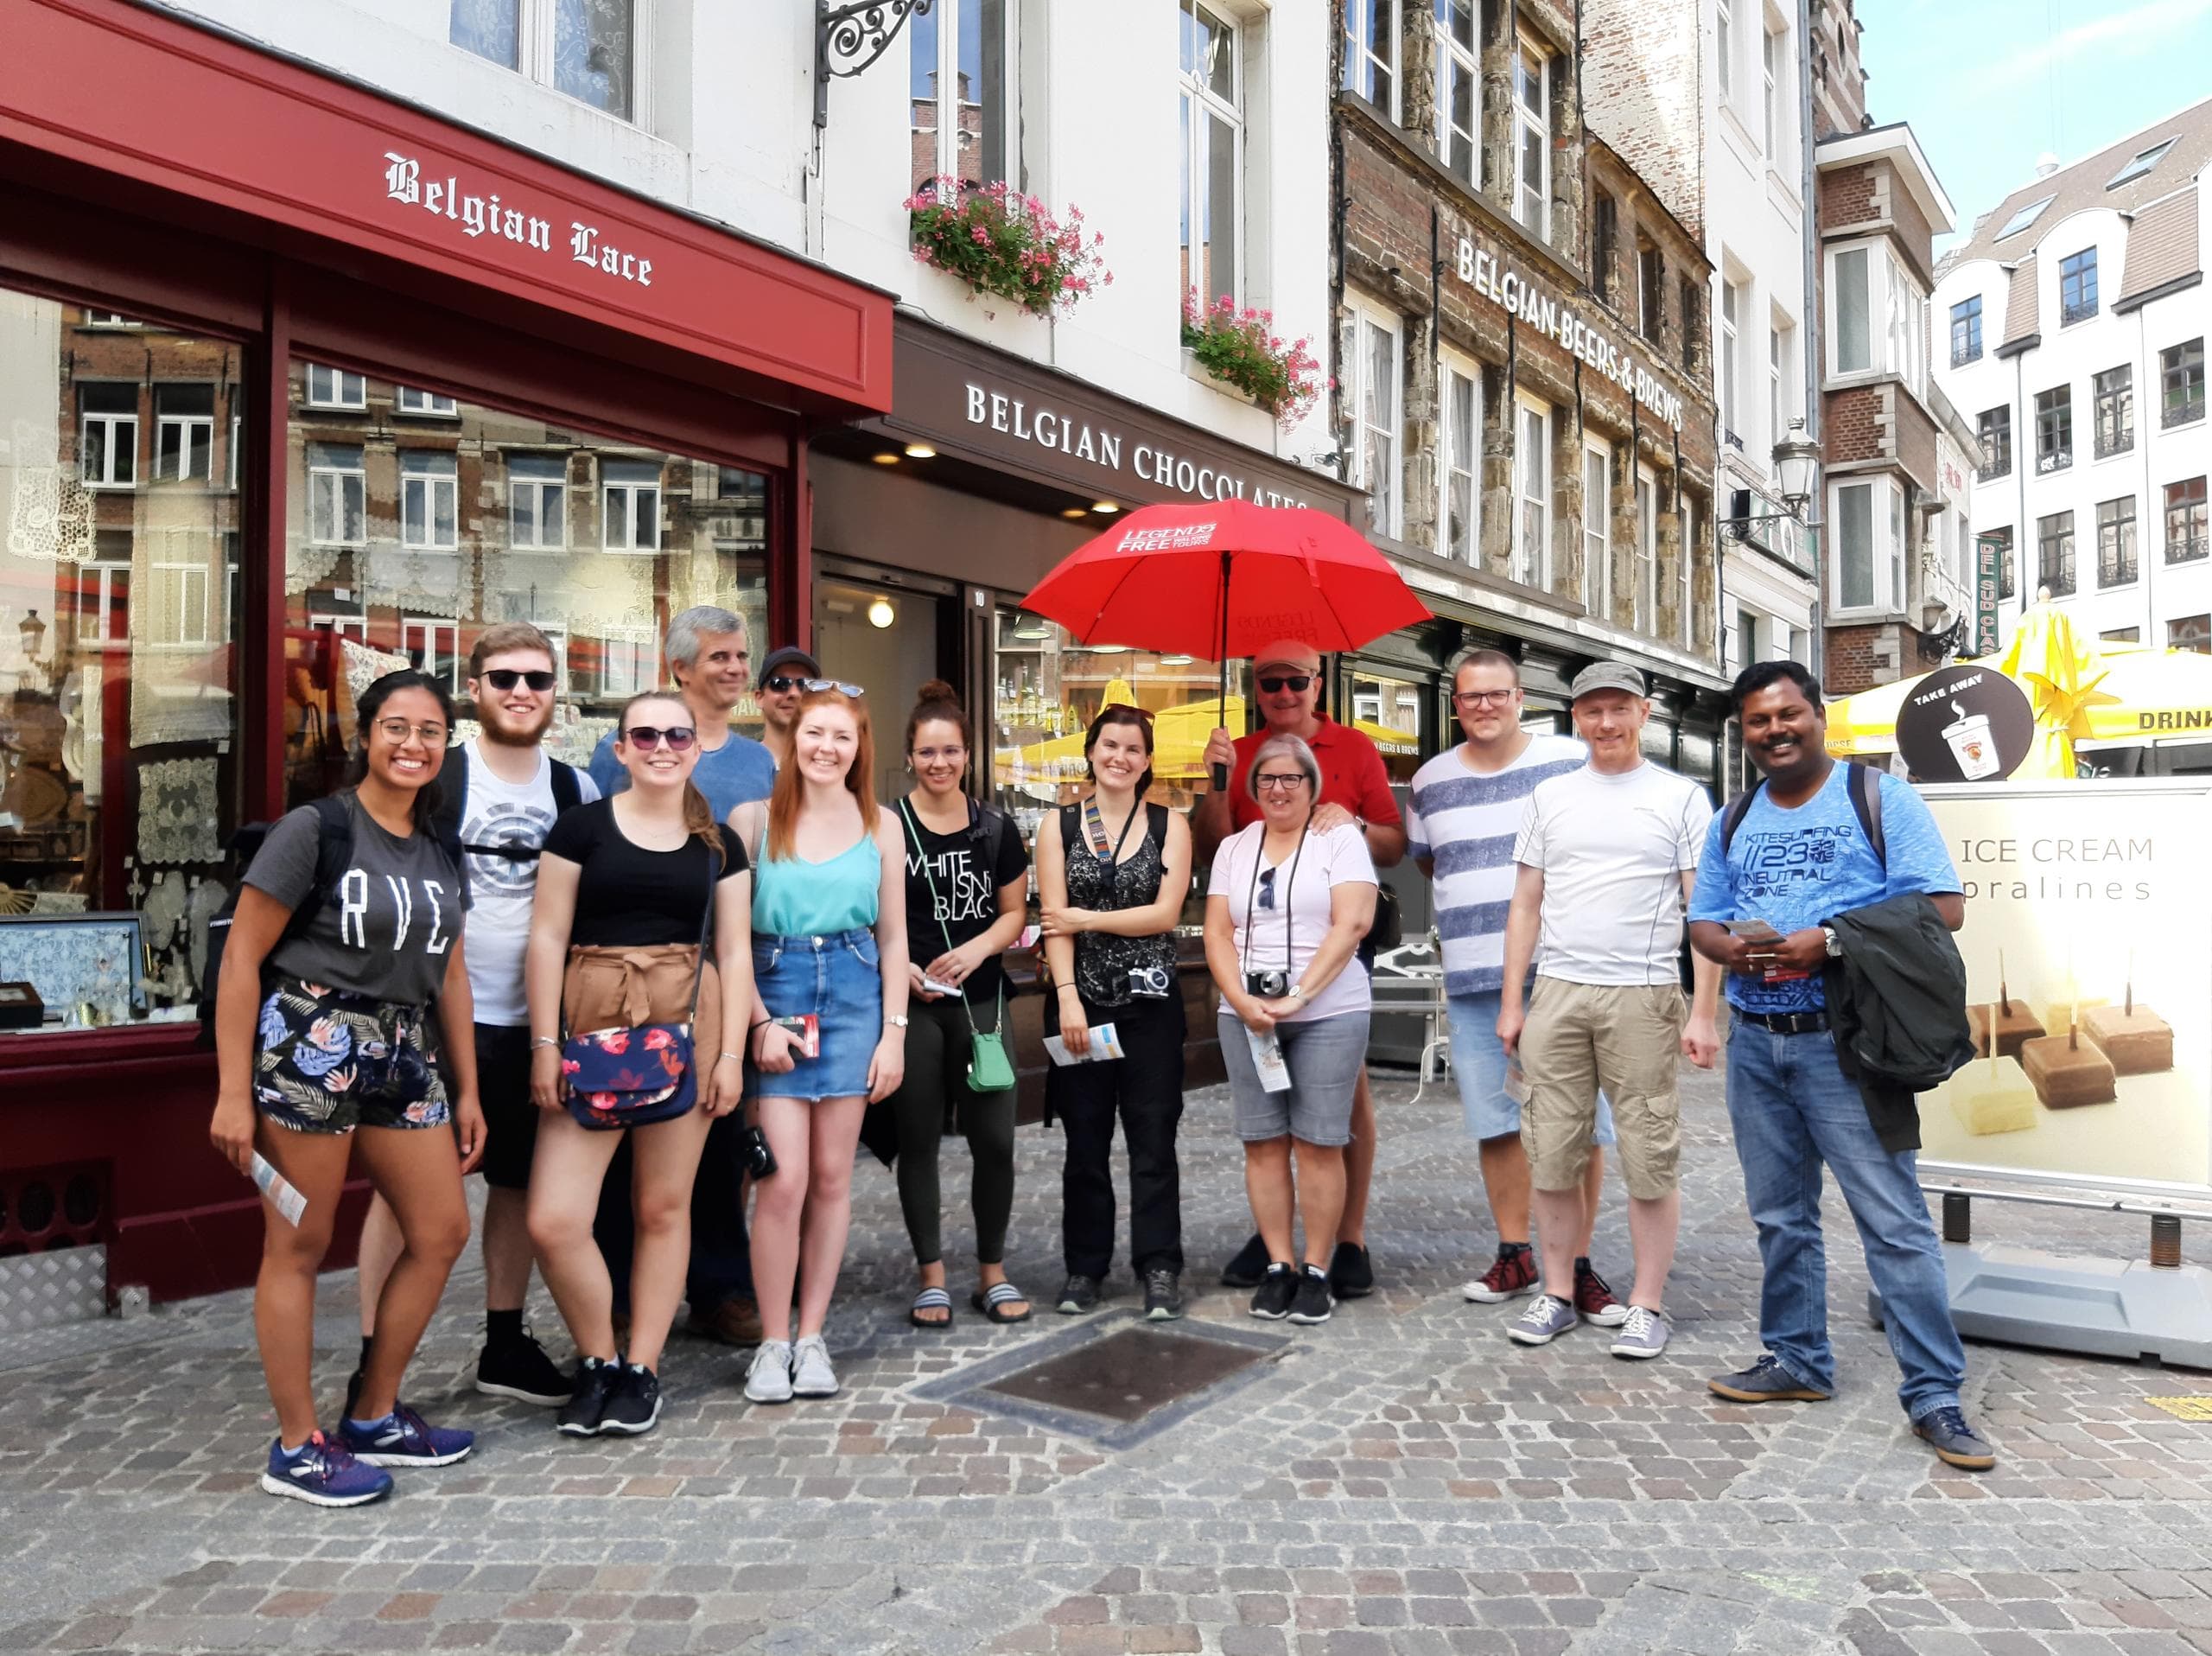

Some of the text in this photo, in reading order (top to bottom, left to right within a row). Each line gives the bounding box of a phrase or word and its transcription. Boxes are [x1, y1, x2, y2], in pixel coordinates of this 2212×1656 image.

[384, 152, 652, 286] Belgian Lace
[1458, 238, 1683, 433] BELGIAN BEERS & BREWS
[966, 385, 1122, 470] BELGIAN
[1125, 522, 1217, 540] LEGENDS
[1116, 538, 1173, 553] FREE
[1980, 544, 1996, 576] DEL
[975, 591, 985, 607] 10
[1980, 579, 1995, 611] SUD
[1913, 673, 1983, 706] TAKE AWAY
[1378, 742, 1396, 753] BEERS
[1961, 838, 2152, 863] ICE CREAM
[1745, 868, 1831, 885] NEUTRAL
[1745, 883, 1789, 900] ZONE
[1962, 876, 2151, 904] pralines
